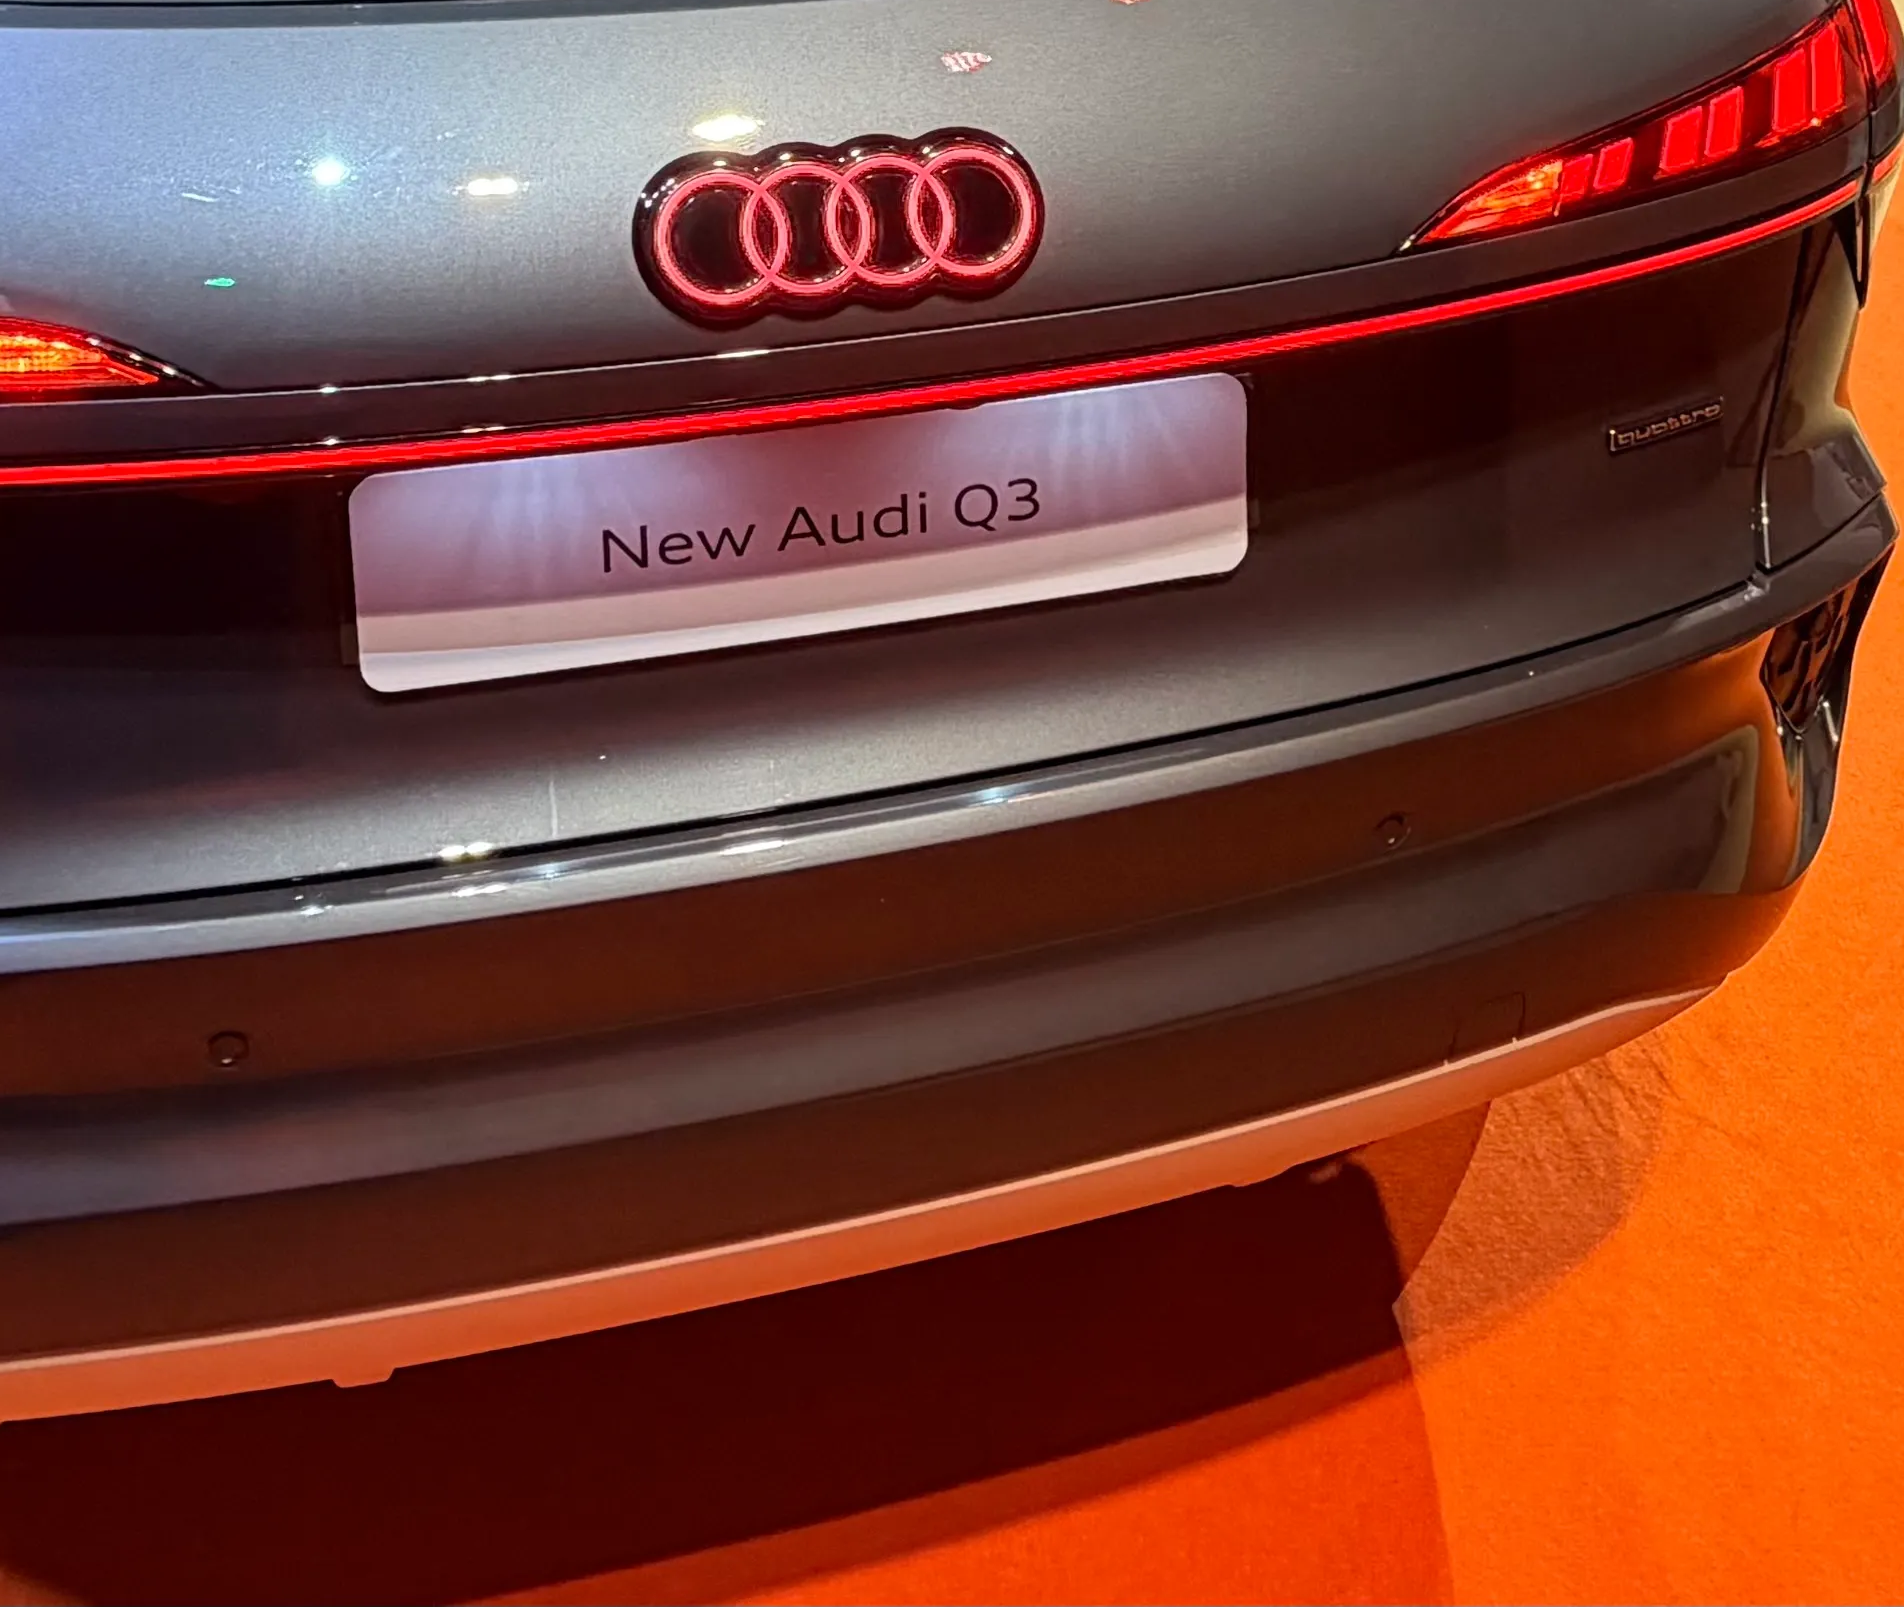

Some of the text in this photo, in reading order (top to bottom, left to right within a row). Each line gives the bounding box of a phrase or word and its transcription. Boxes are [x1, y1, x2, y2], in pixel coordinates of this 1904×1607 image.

[601, 477, 1041, 573] New Audi Q3
